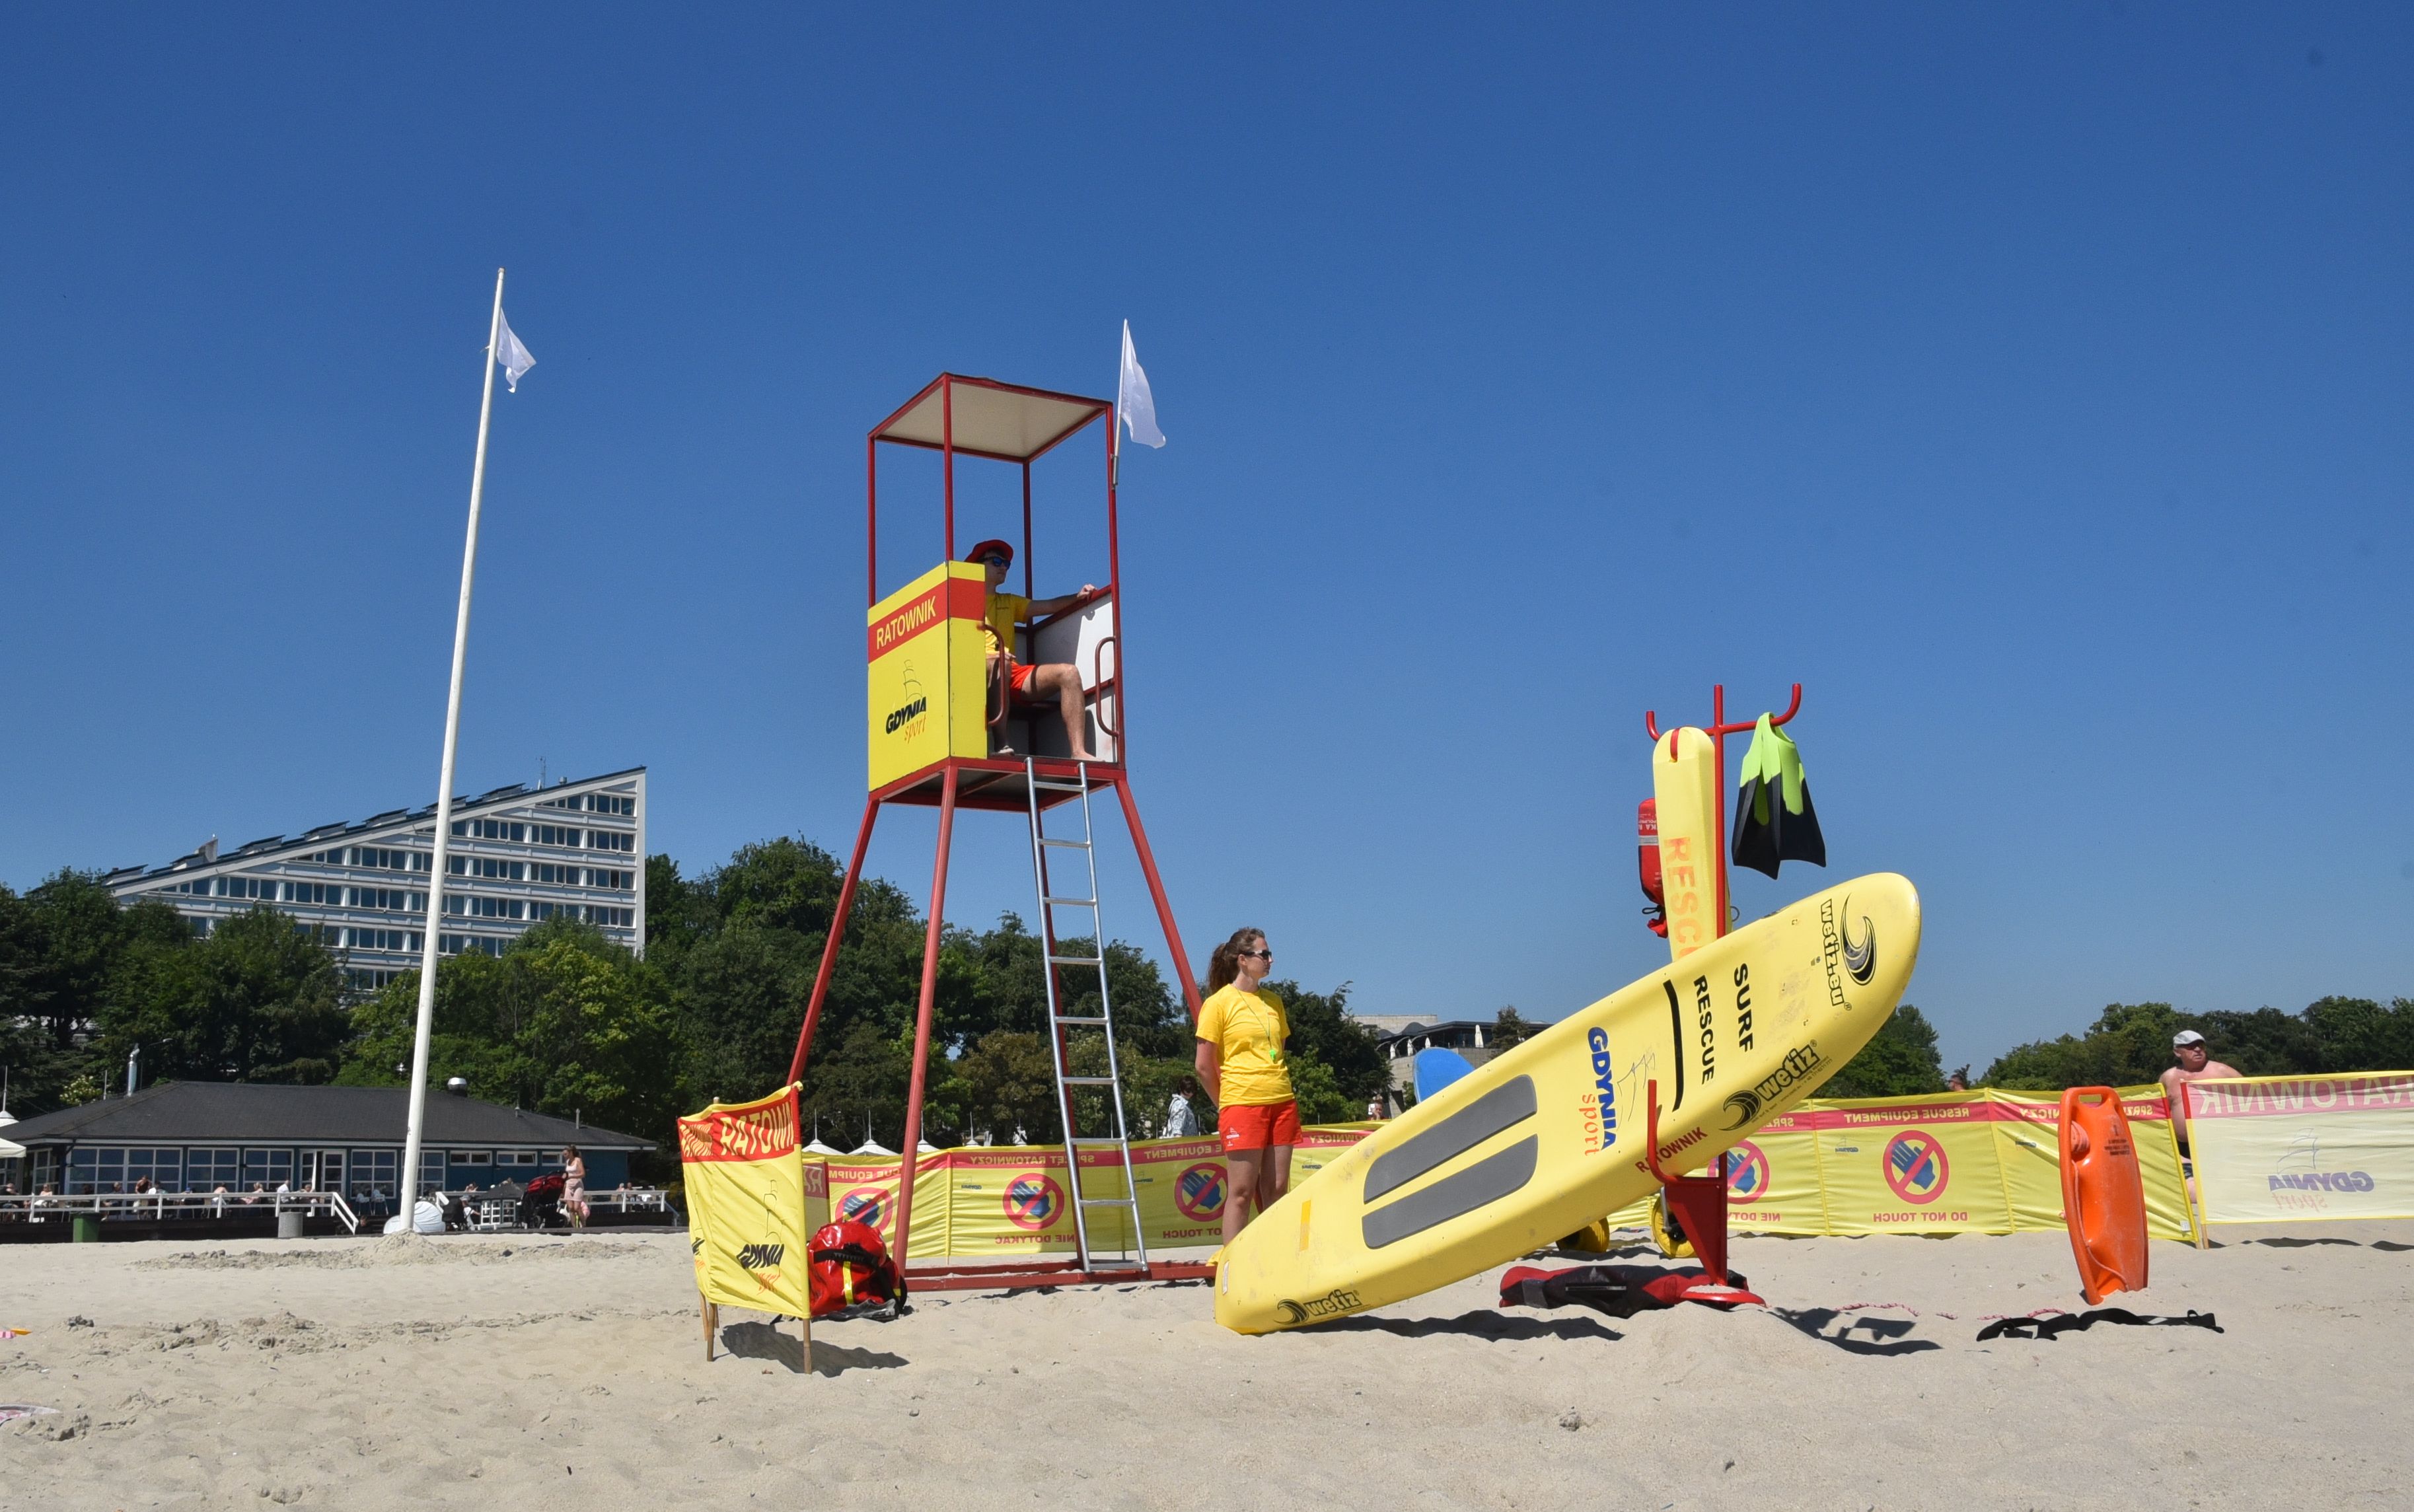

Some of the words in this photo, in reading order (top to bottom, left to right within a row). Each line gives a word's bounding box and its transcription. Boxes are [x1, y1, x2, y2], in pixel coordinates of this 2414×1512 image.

[876, 596, 936, 650] RATOWNIK
[885, 696, 927, 735] GDYNIA
[904, 716, 927, 744] sport
[1664, 836, 1703, 956] RESC
[1821, 898, 1845, 1006] wetiz.eu
[1693, 974, 1715, 1085] RESCUE
[1734, 963, 1753, 1052] SURF
[1588, 1026, 1617, 1151] GDYNIA
[1753, 1044, 1821, 1102] wetiz
[719, 1101, 794, 1156] RATOWN
[1578, 1093, 1600, 1156] sport
[1634, 1126, 1708, 1173] RTOWNIK
[1303, 1289, 1362, 1316] wetiz
